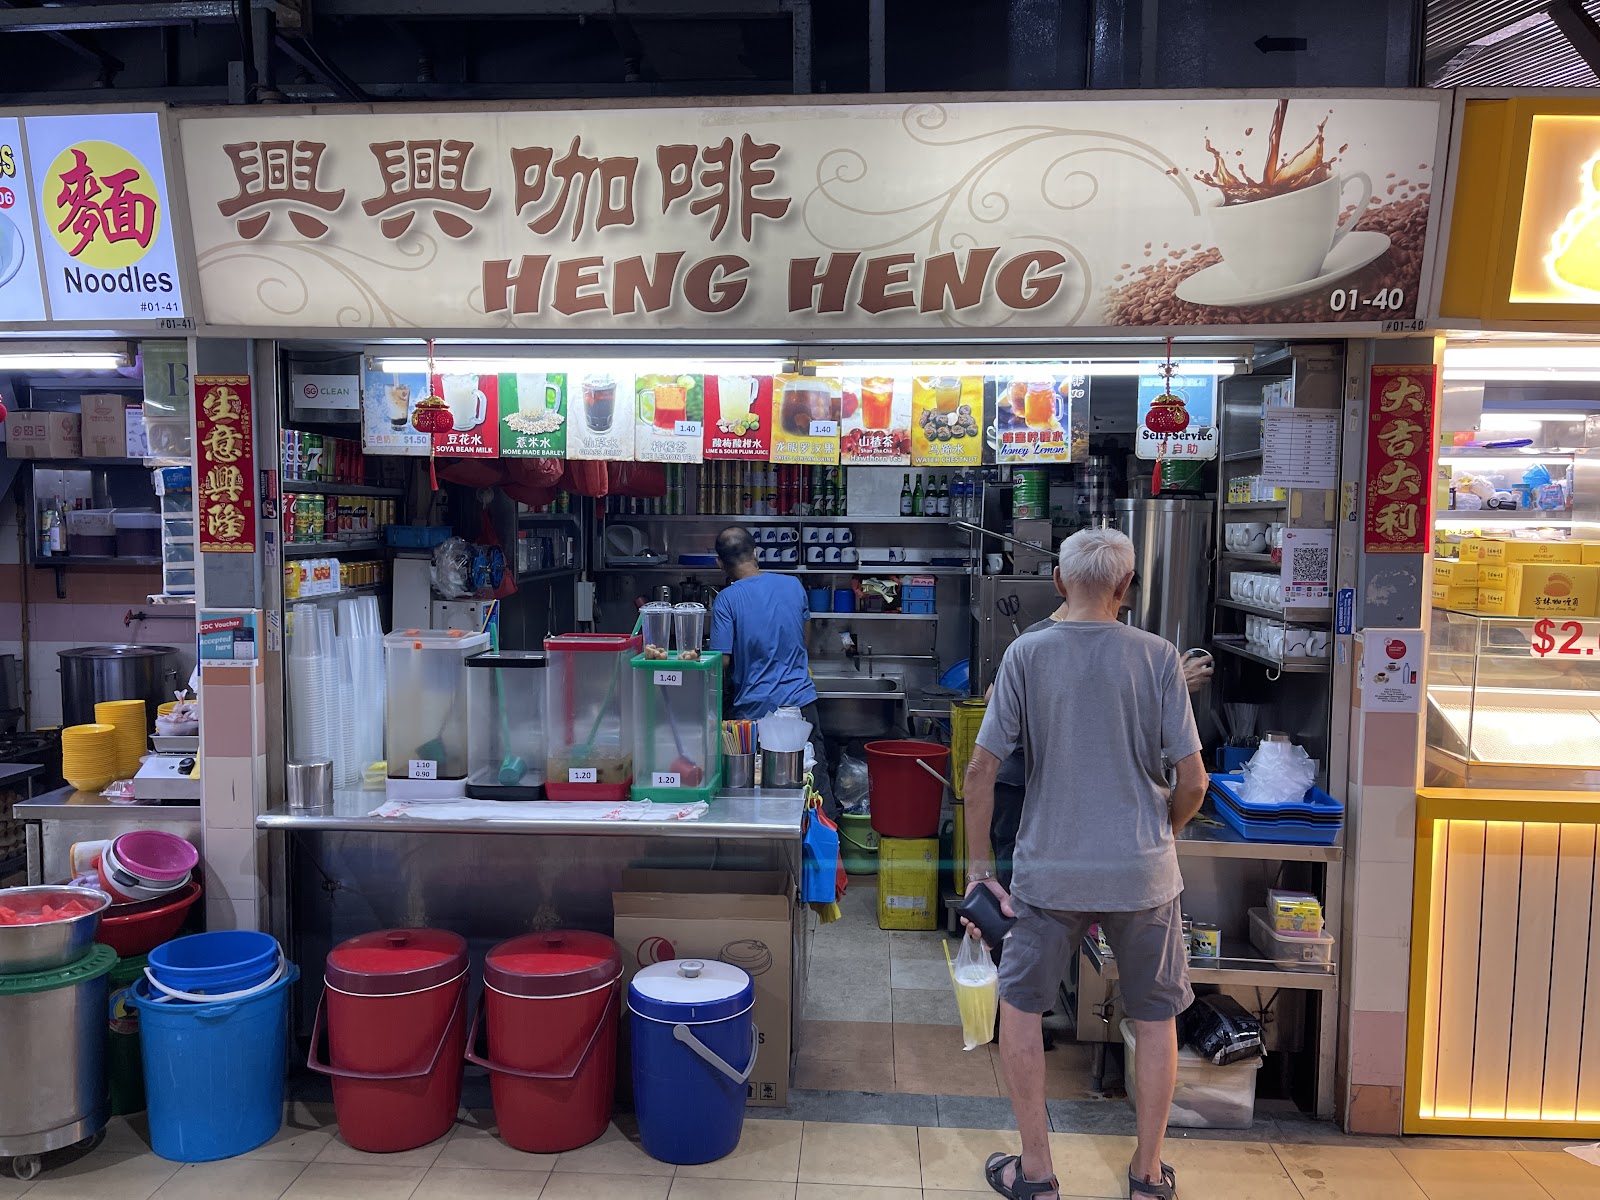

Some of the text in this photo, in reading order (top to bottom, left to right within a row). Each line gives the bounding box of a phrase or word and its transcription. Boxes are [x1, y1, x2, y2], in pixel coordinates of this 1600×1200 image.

[217, 134, 791, 242] 興興咖啡
[57, 149, 157, 257] 麵
[64, 266, 173, 293] Noodles
[482, 246, 1067, 316] HENG HENG
[1330, 288, 1404, 311] 01-40
[140, 302, 178, 312] #01-41
[160, 319, 191, 329] #01-41
[1386, 320, 1424, 331] #01-40
[320, 387, 350, 396] CLEAN
[815, 425, 831, 433] 1.40
[403, 435, 427, 444] $1.50
[447, 433, 483, 445] 豆花水
[1001, 444, 1065, 457] honey Lemon
[202, 386, 245, 538] 生意興隆
[890, 455, 902, 463] Tea
[1376, 376, 1422, 537] 大吉大利
[214, 620, 240, 628] Voucher
[200, 635, 231, 645] Accepted
[1532, 617, 1600, 658] $2.
[660, 674, 677, 682] 1.40
[658, 776, 675, 784] 1.20
